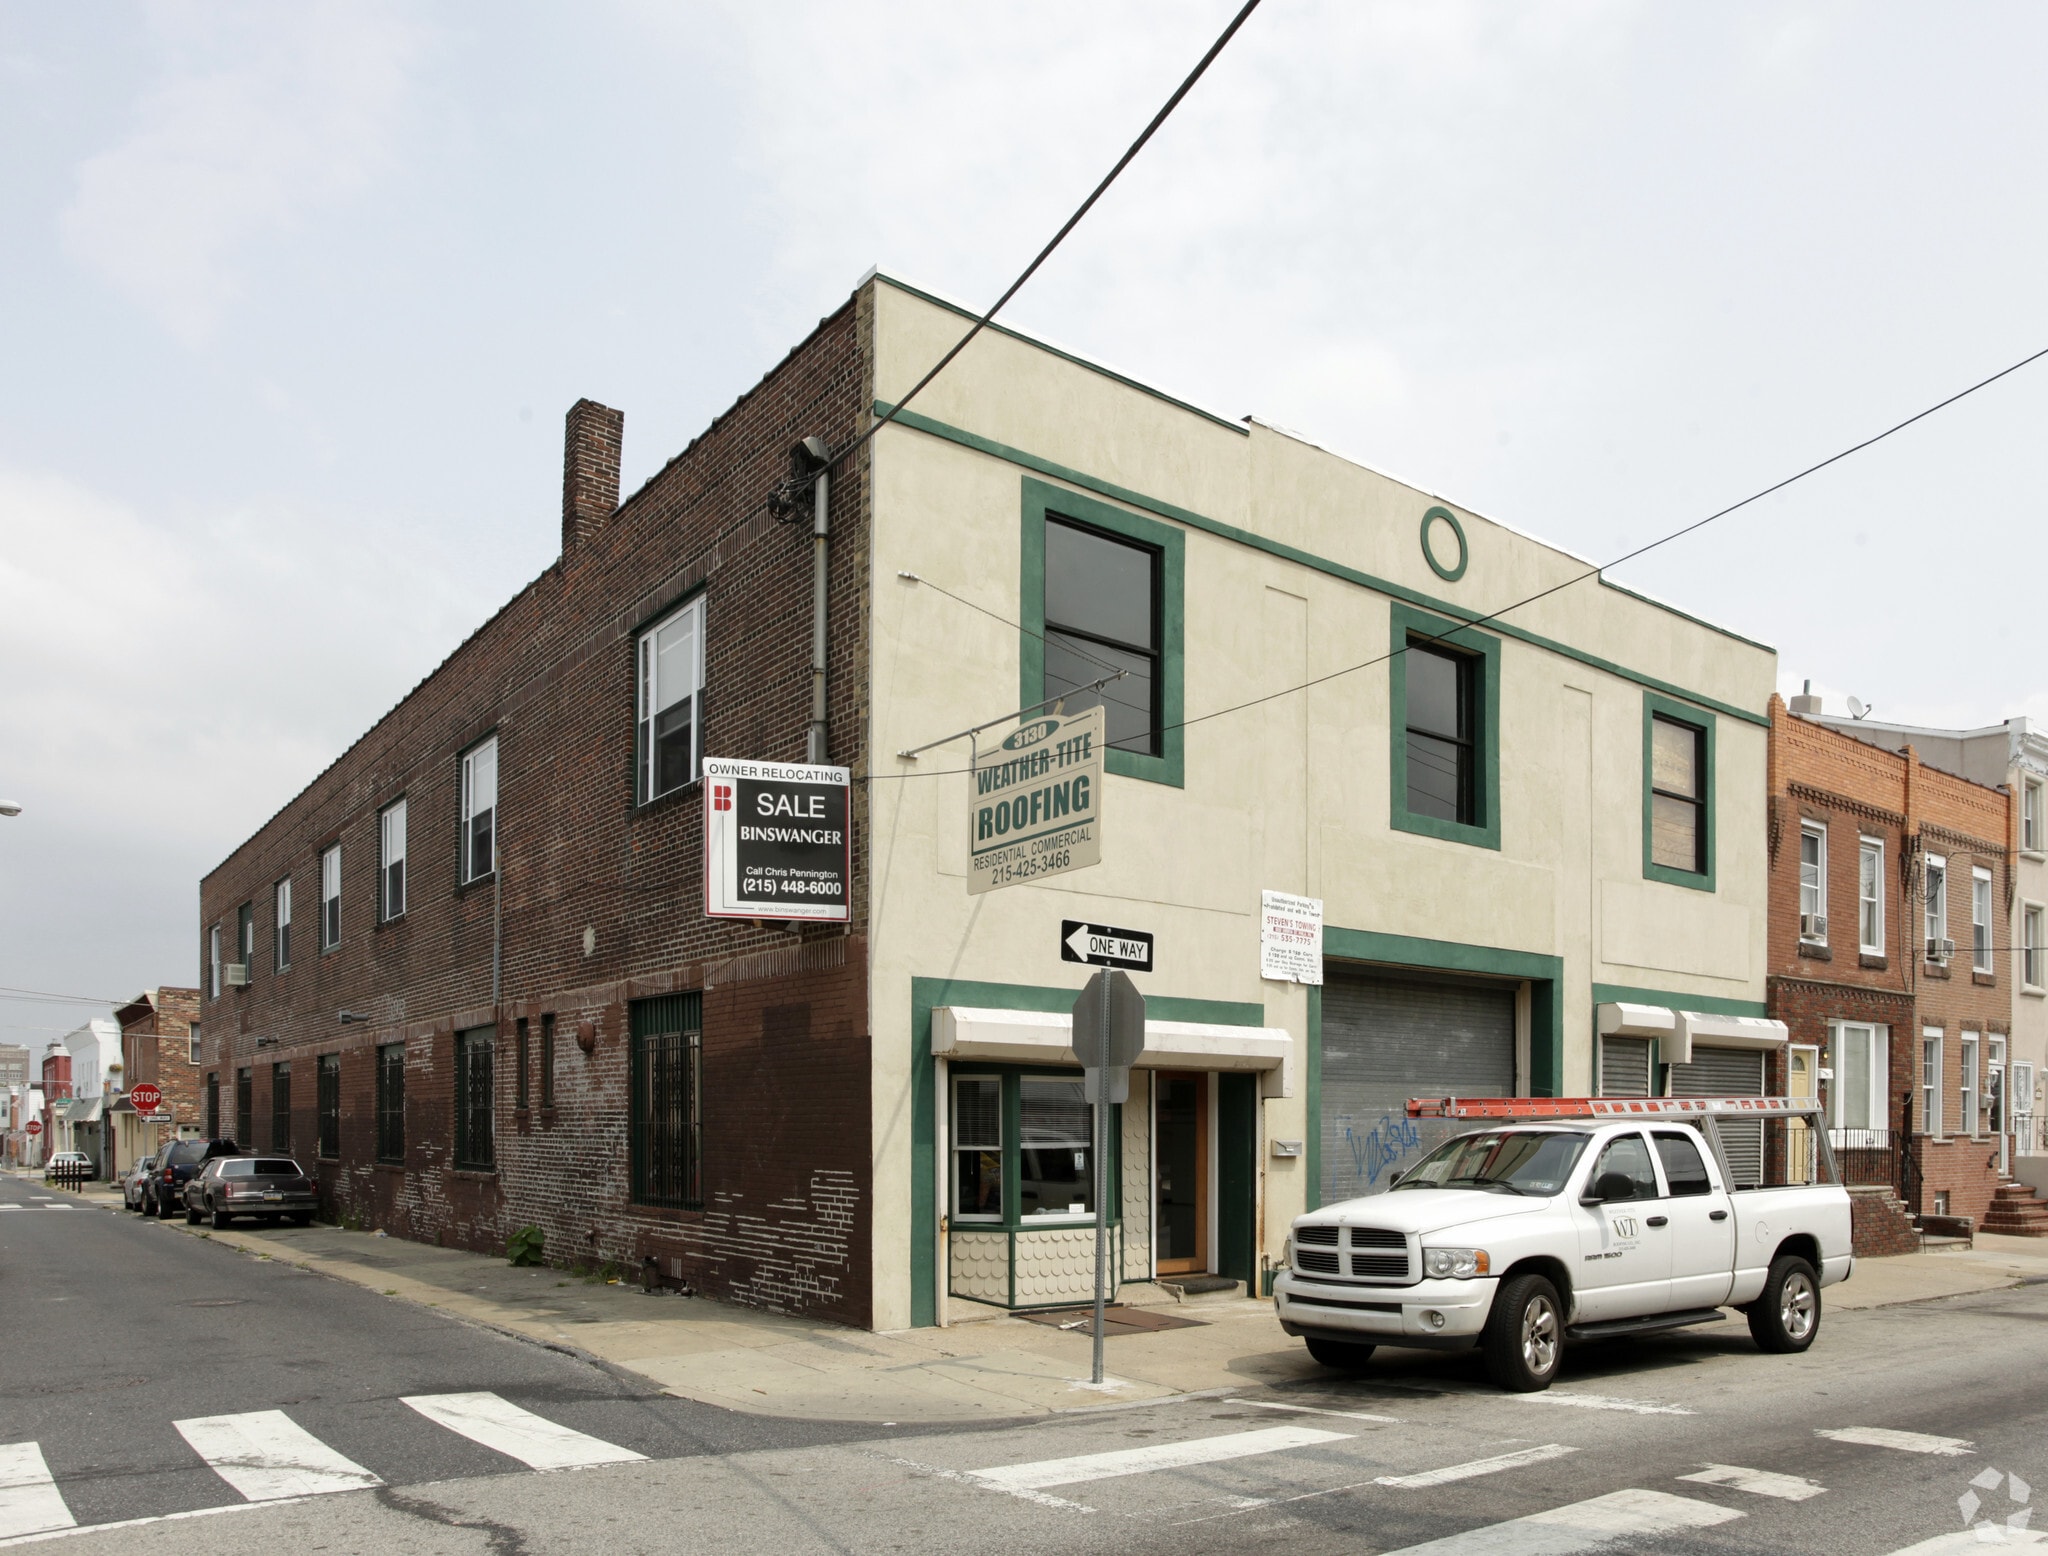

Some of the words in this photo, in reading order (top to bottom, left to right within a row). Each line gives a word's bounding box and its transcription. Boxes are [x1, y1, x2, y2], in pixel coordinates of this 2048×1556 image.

[1013, 722, 1047, 749] 3130
[708, 763, 758, 777] OWNER
[762, 766, 843, 783] RELOCATING
[977, 731, 1092, 796] WEATHER-TITE
[756, 792, 826, 819] SALE
[978, 774, 1090, 841] ROOFING
[740, 826, 842, 845] BINSWANGER
[973, 845, 1026, 872] RESIDENTIAL
[1030, 827, 1092, 856] COMMERCIAL
[746, 866, 763, 876] Call
[765, 867, 788, 877] Chris
[790, 868, 838, 880] Pennington
[992, 850, 1070, 885] 215-425-3466
[742, 878, 777, 896] (215)
[781, 880, 842, 896] 448-6000
[758, 906, 827, 915] www.binswanger.com
[1295, 920, 1317, 932] TOWING
[1090, 936, 1114, 955] ONE
[1119, 940, 1144, 960] WAY
[132, 1091, 161, 1103] STOP
[1612, 1219, 1636, 1237] WT
[1585, 1253, 1603, 1262] RAM
[1604, 1251, 1623, 1260] 1500
